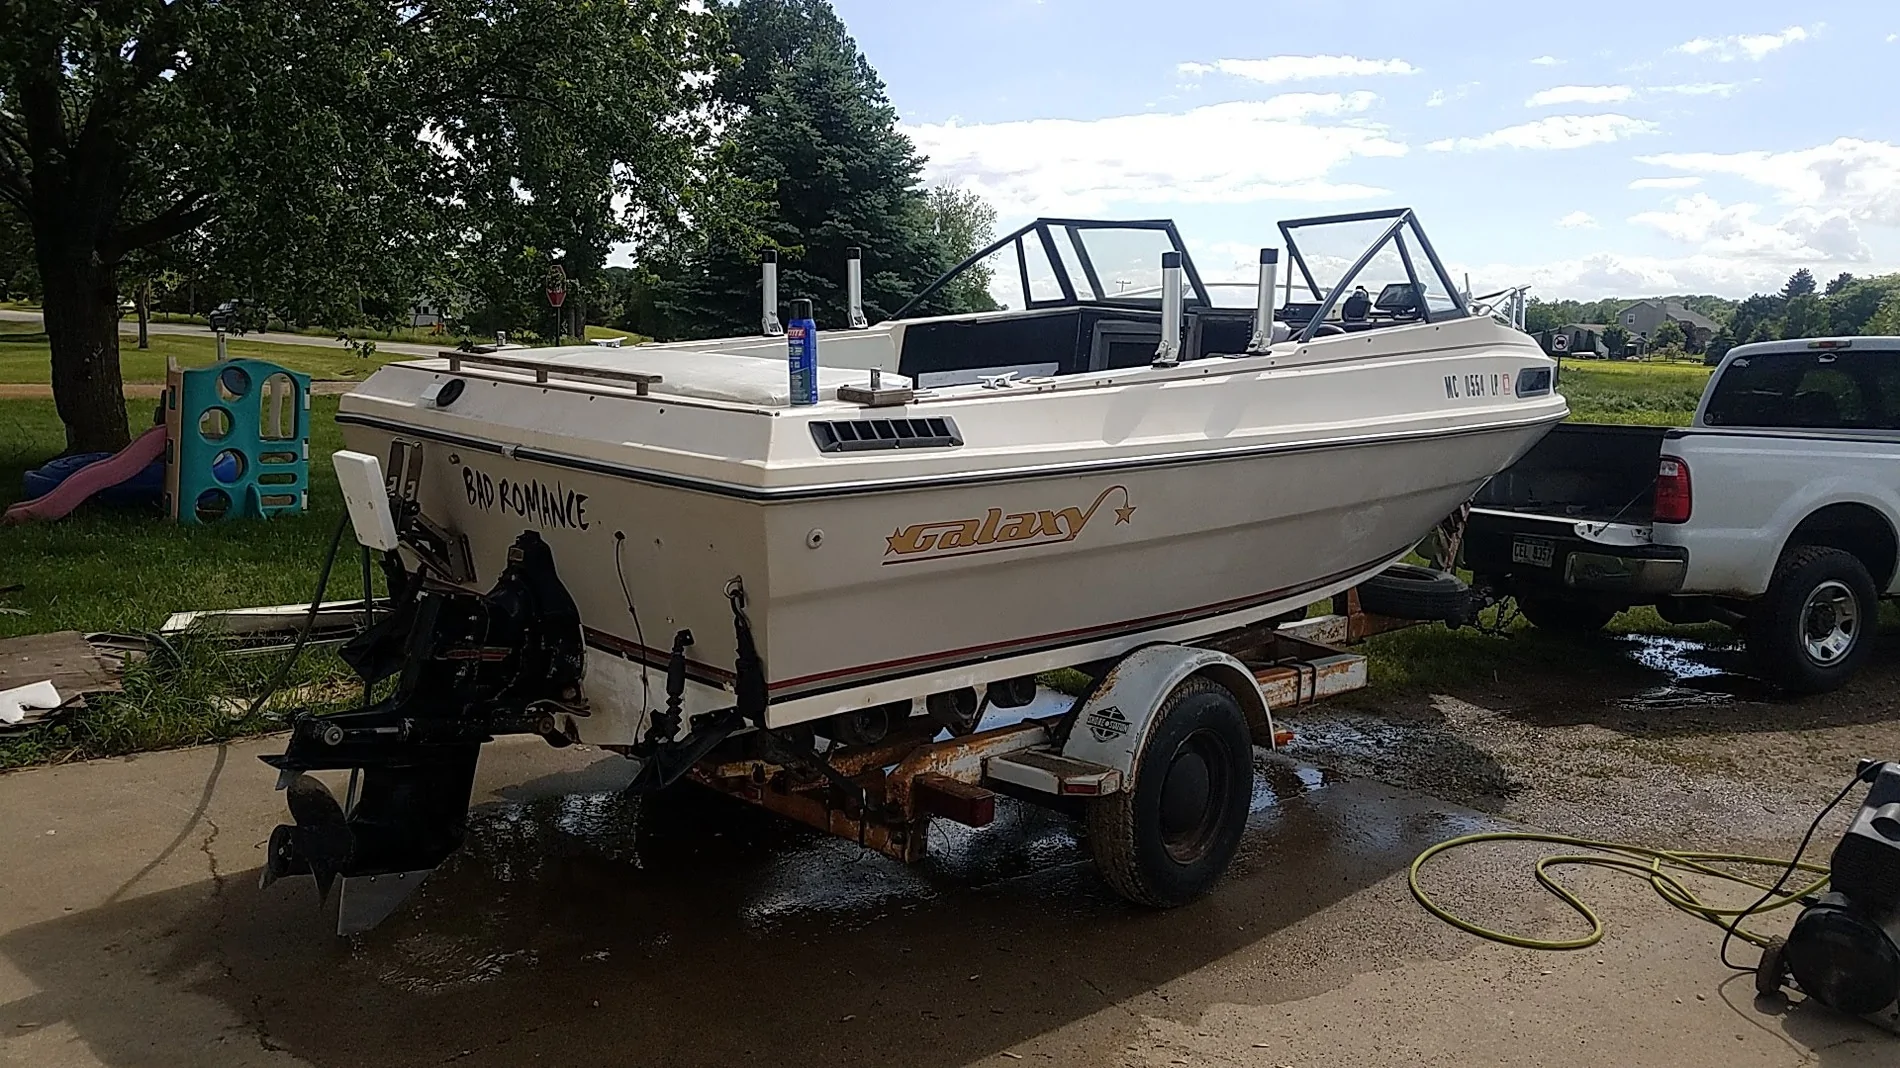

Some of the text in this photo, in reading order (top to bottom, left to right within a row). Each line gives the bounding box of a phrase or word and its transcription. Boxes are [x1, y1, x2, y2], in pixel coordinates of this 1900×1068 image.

[1444, 375, 1459, 398] MC
[462, 466, 589, 531] BAD ROMANCE
[897, 490, 1108, 555] Galaxy
[1514, 543, 1528, 559] CEL
